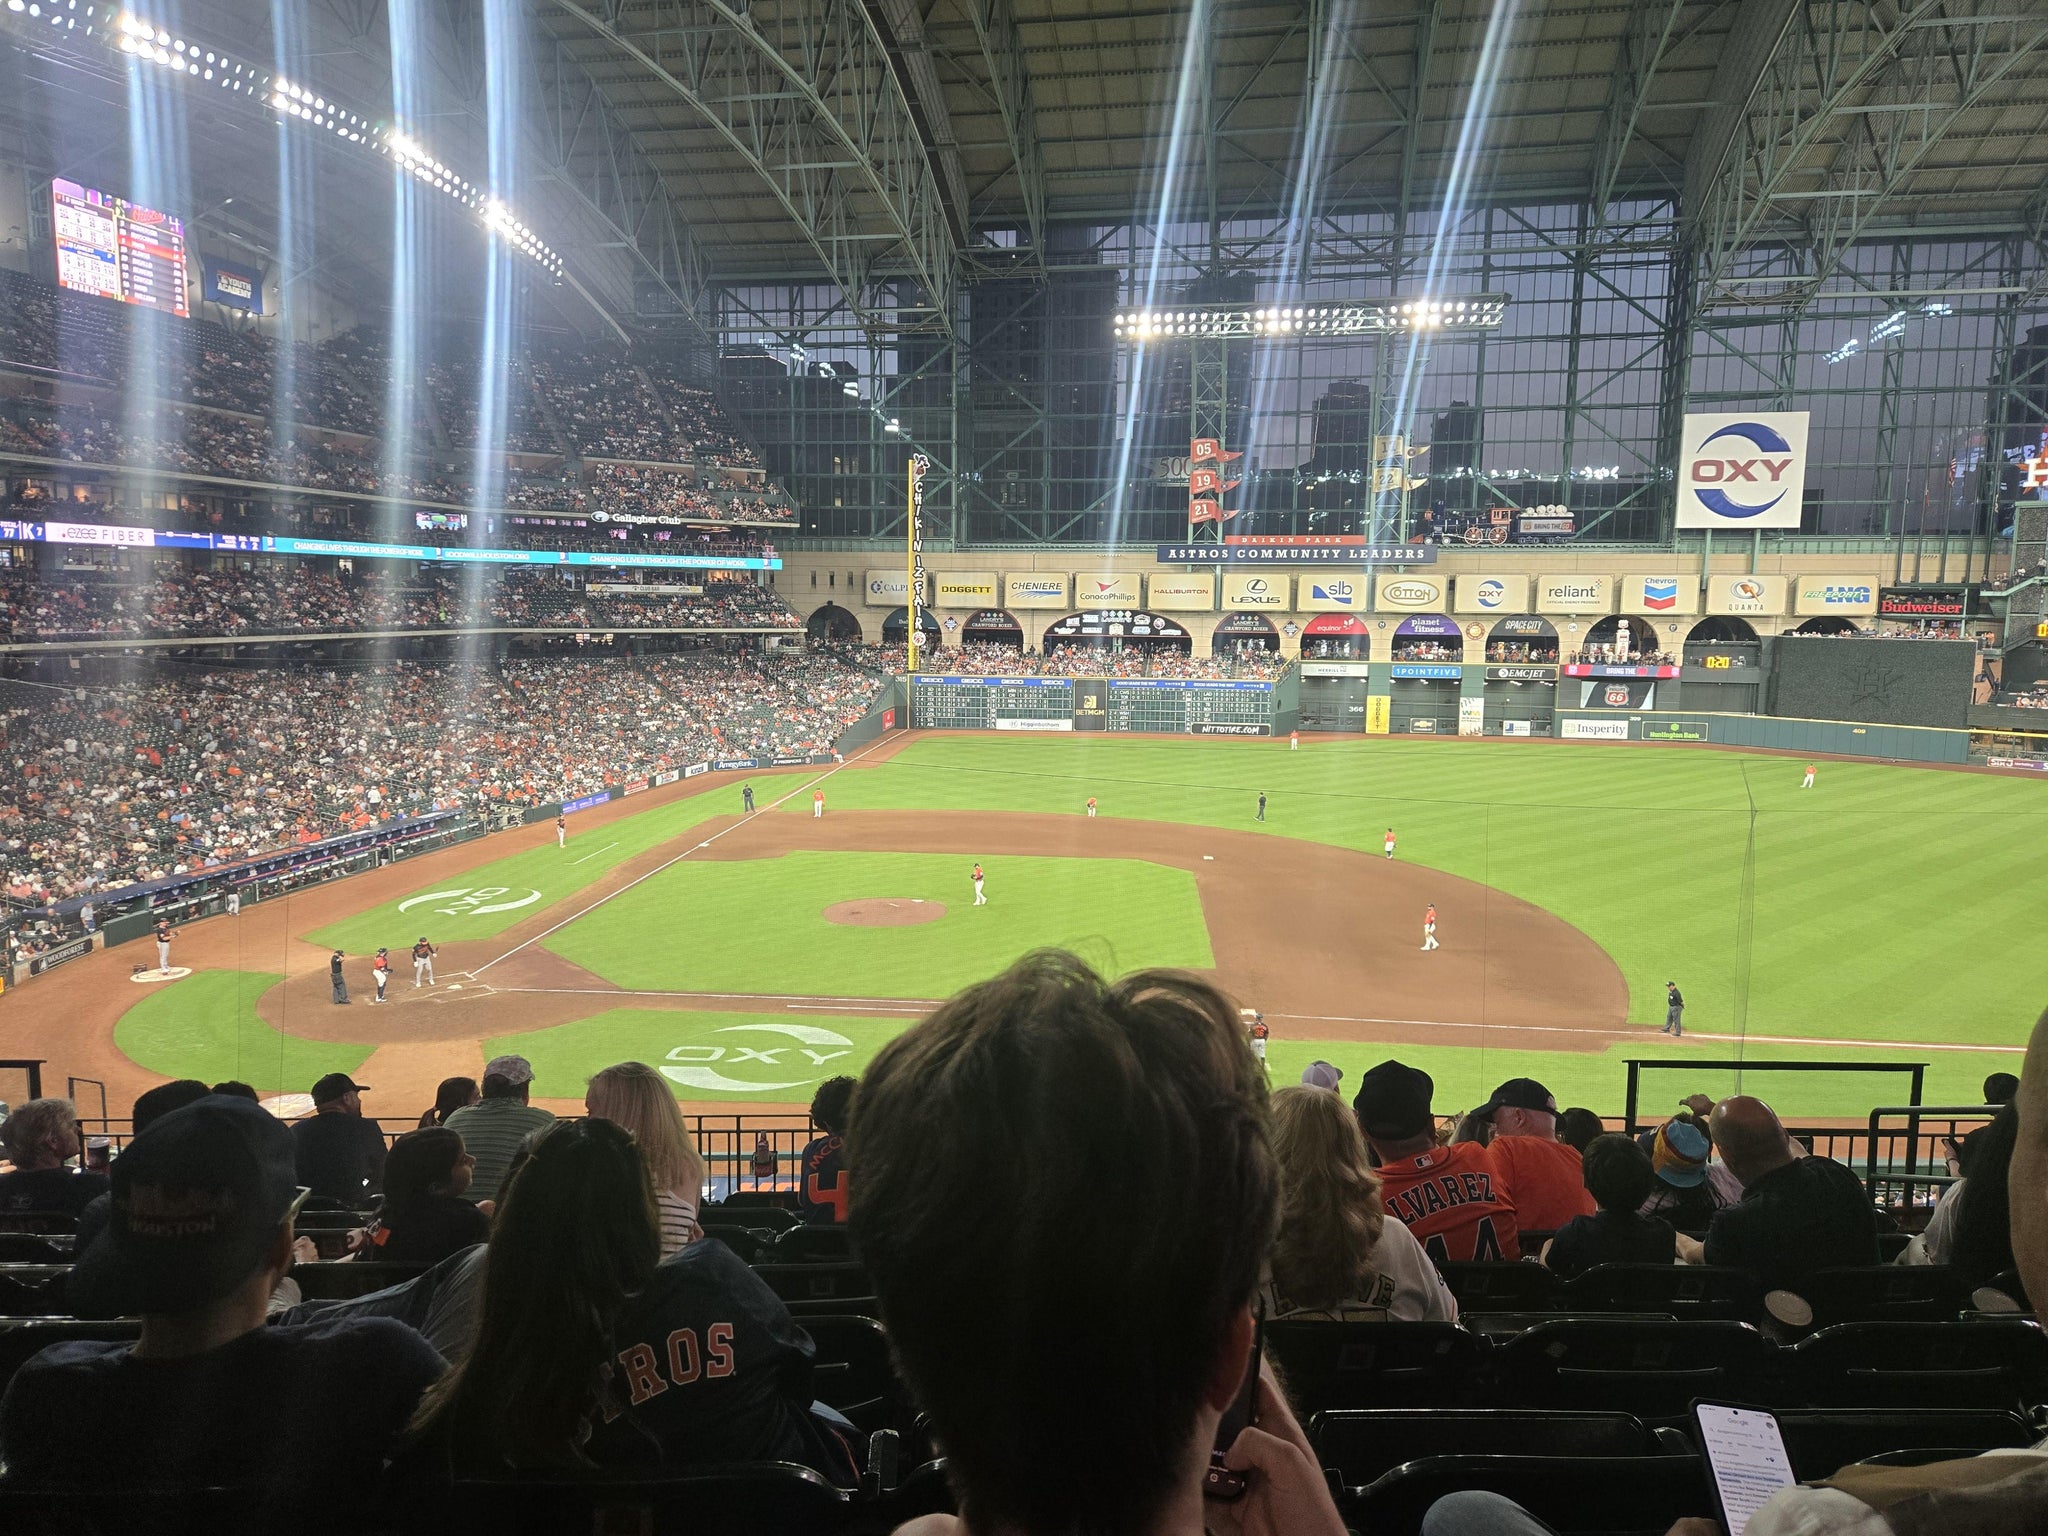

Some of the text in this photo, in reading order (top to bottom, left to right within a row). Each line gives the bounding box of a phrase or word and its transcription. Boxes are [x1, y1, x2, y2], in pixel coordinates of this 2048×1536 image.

[229, 277, 251, 290] YOUTH
[217, 282, 251, 298] ACADEMY
[1196, 443, 1212, 456] 05
[1692, 459, 1794, 482] OXY
[1196, 475, 1211, 487] 19
[1380, 474, 1394, 484] 22
[913, 481, 923, 551] CHIKIN
[1195, 504, 1209, 516] 21
[612, 513, 657, 524] Gallagher
[658, 516, 681, 525] Club
[23, 523, 35, 539] K
[67, 527, 145, 542] ezee FIBER
[1168, 550, 1424, 558] ASTROS COMMUNITY LEADERS
[1012, 582, 1062, 590] CHENIERE
[1328, 581, 1352, 595] slb
[1549, 586, 1596, 598] reliant
[1080, 592, 1136, 602] ConocoPhillips
[1390, 587, 1431, 600] COTTON
[1825, 587, 1872, 603] LNG
[914, 582, 924, 630] FAIR
[1882, 601, 1962, 614] Budweiser
[1412, 619, 1440, 629] planet
[1505, 620, 1543, 629] SPACE CITY
[1706, 656, 1730, 668] 0:20
[1508, 670, 1546, 679] EMCJET
[1202, 725, 1260, 734] NITTOTIRE.COM
[1578, 724, 1626, 736] Insperity
[1650, 732, 1682, 740] Huntington
[718, 760, 752, 768] AmegyBank
[434, 887, 510, 916] OXY
[47, 942, 85, 964] WOODFOREST
[665, 1046, 853, 1065] OXY
[1386, 1172, 1498, 1226] LVAREZ
[1728, 1418, 1749, 1426] Google
